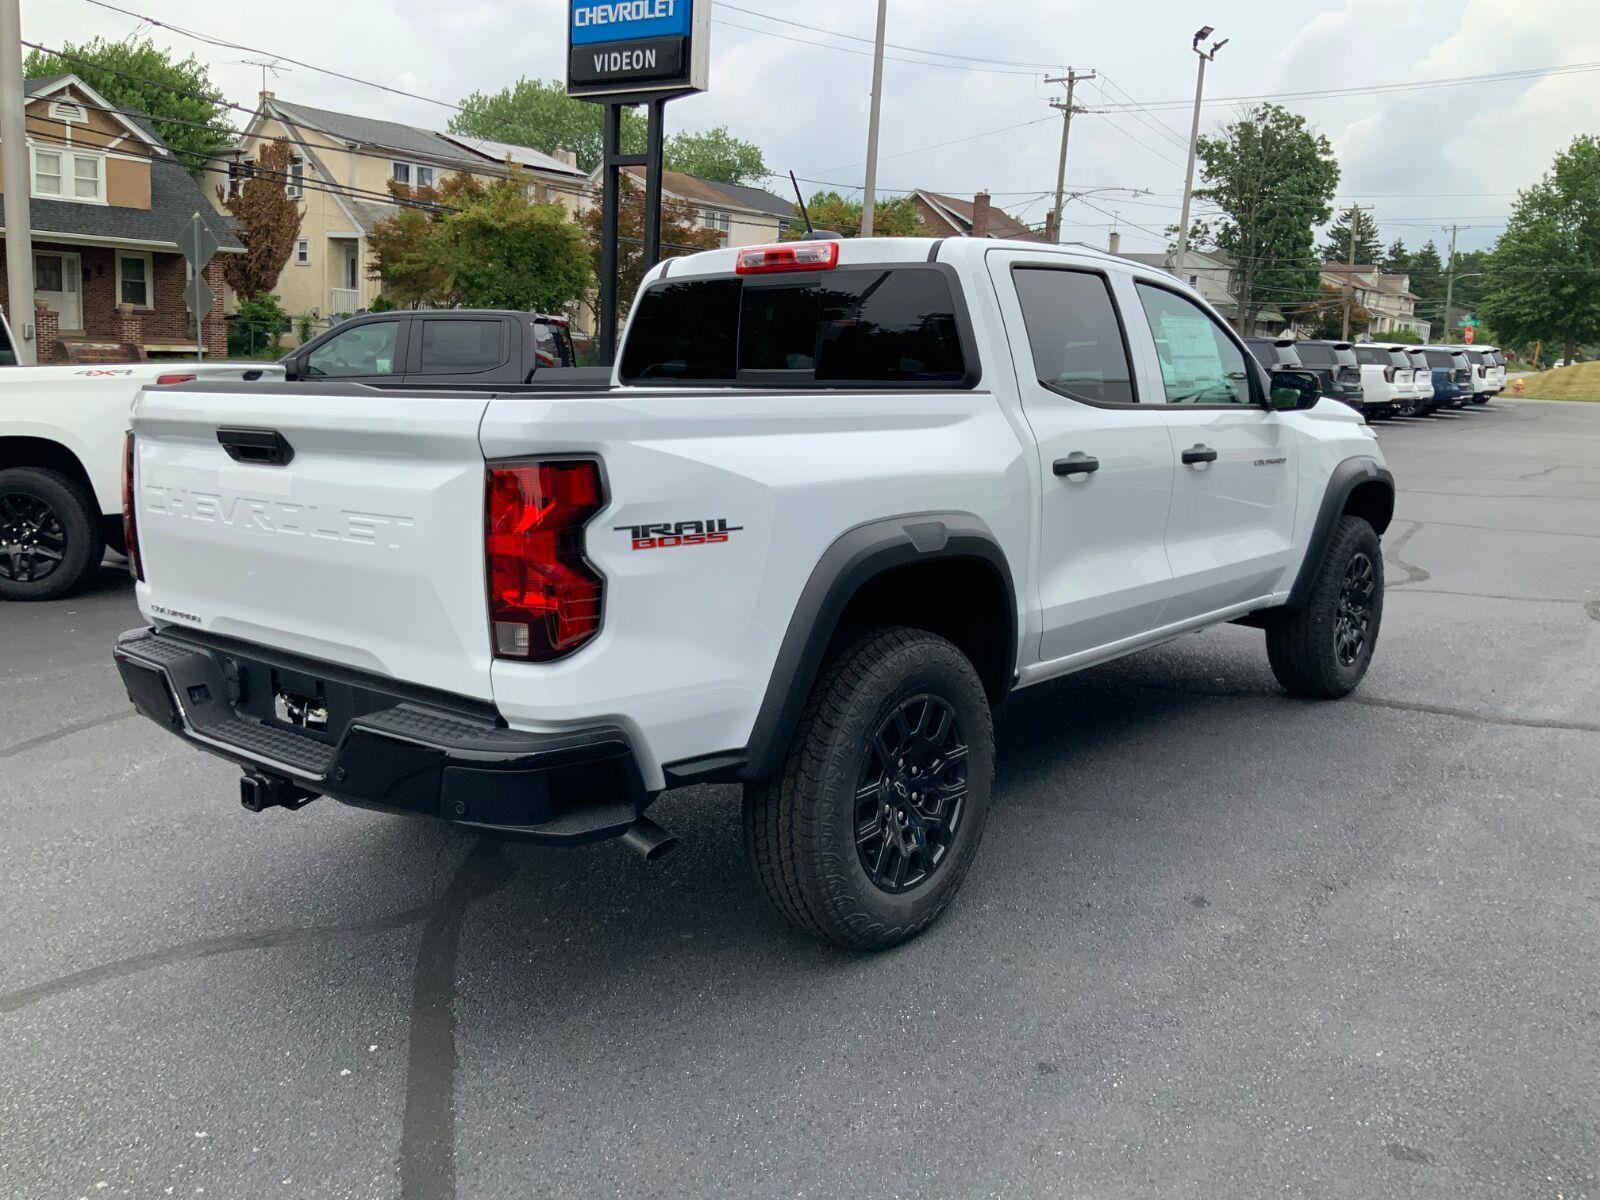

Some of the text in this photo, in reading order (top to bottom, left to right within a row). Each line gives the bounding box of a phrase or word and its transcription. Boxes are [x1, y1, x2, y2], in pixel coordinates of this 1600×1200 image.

[575, 0, 675, 27] CHEVROLET
[594, 49, 656, 73] VIDEON
[146, 484, 415, 548] CHEVROLET
[613, 518, 743, 539] TRAIL
[631, 532, 729, 551] BOSS
